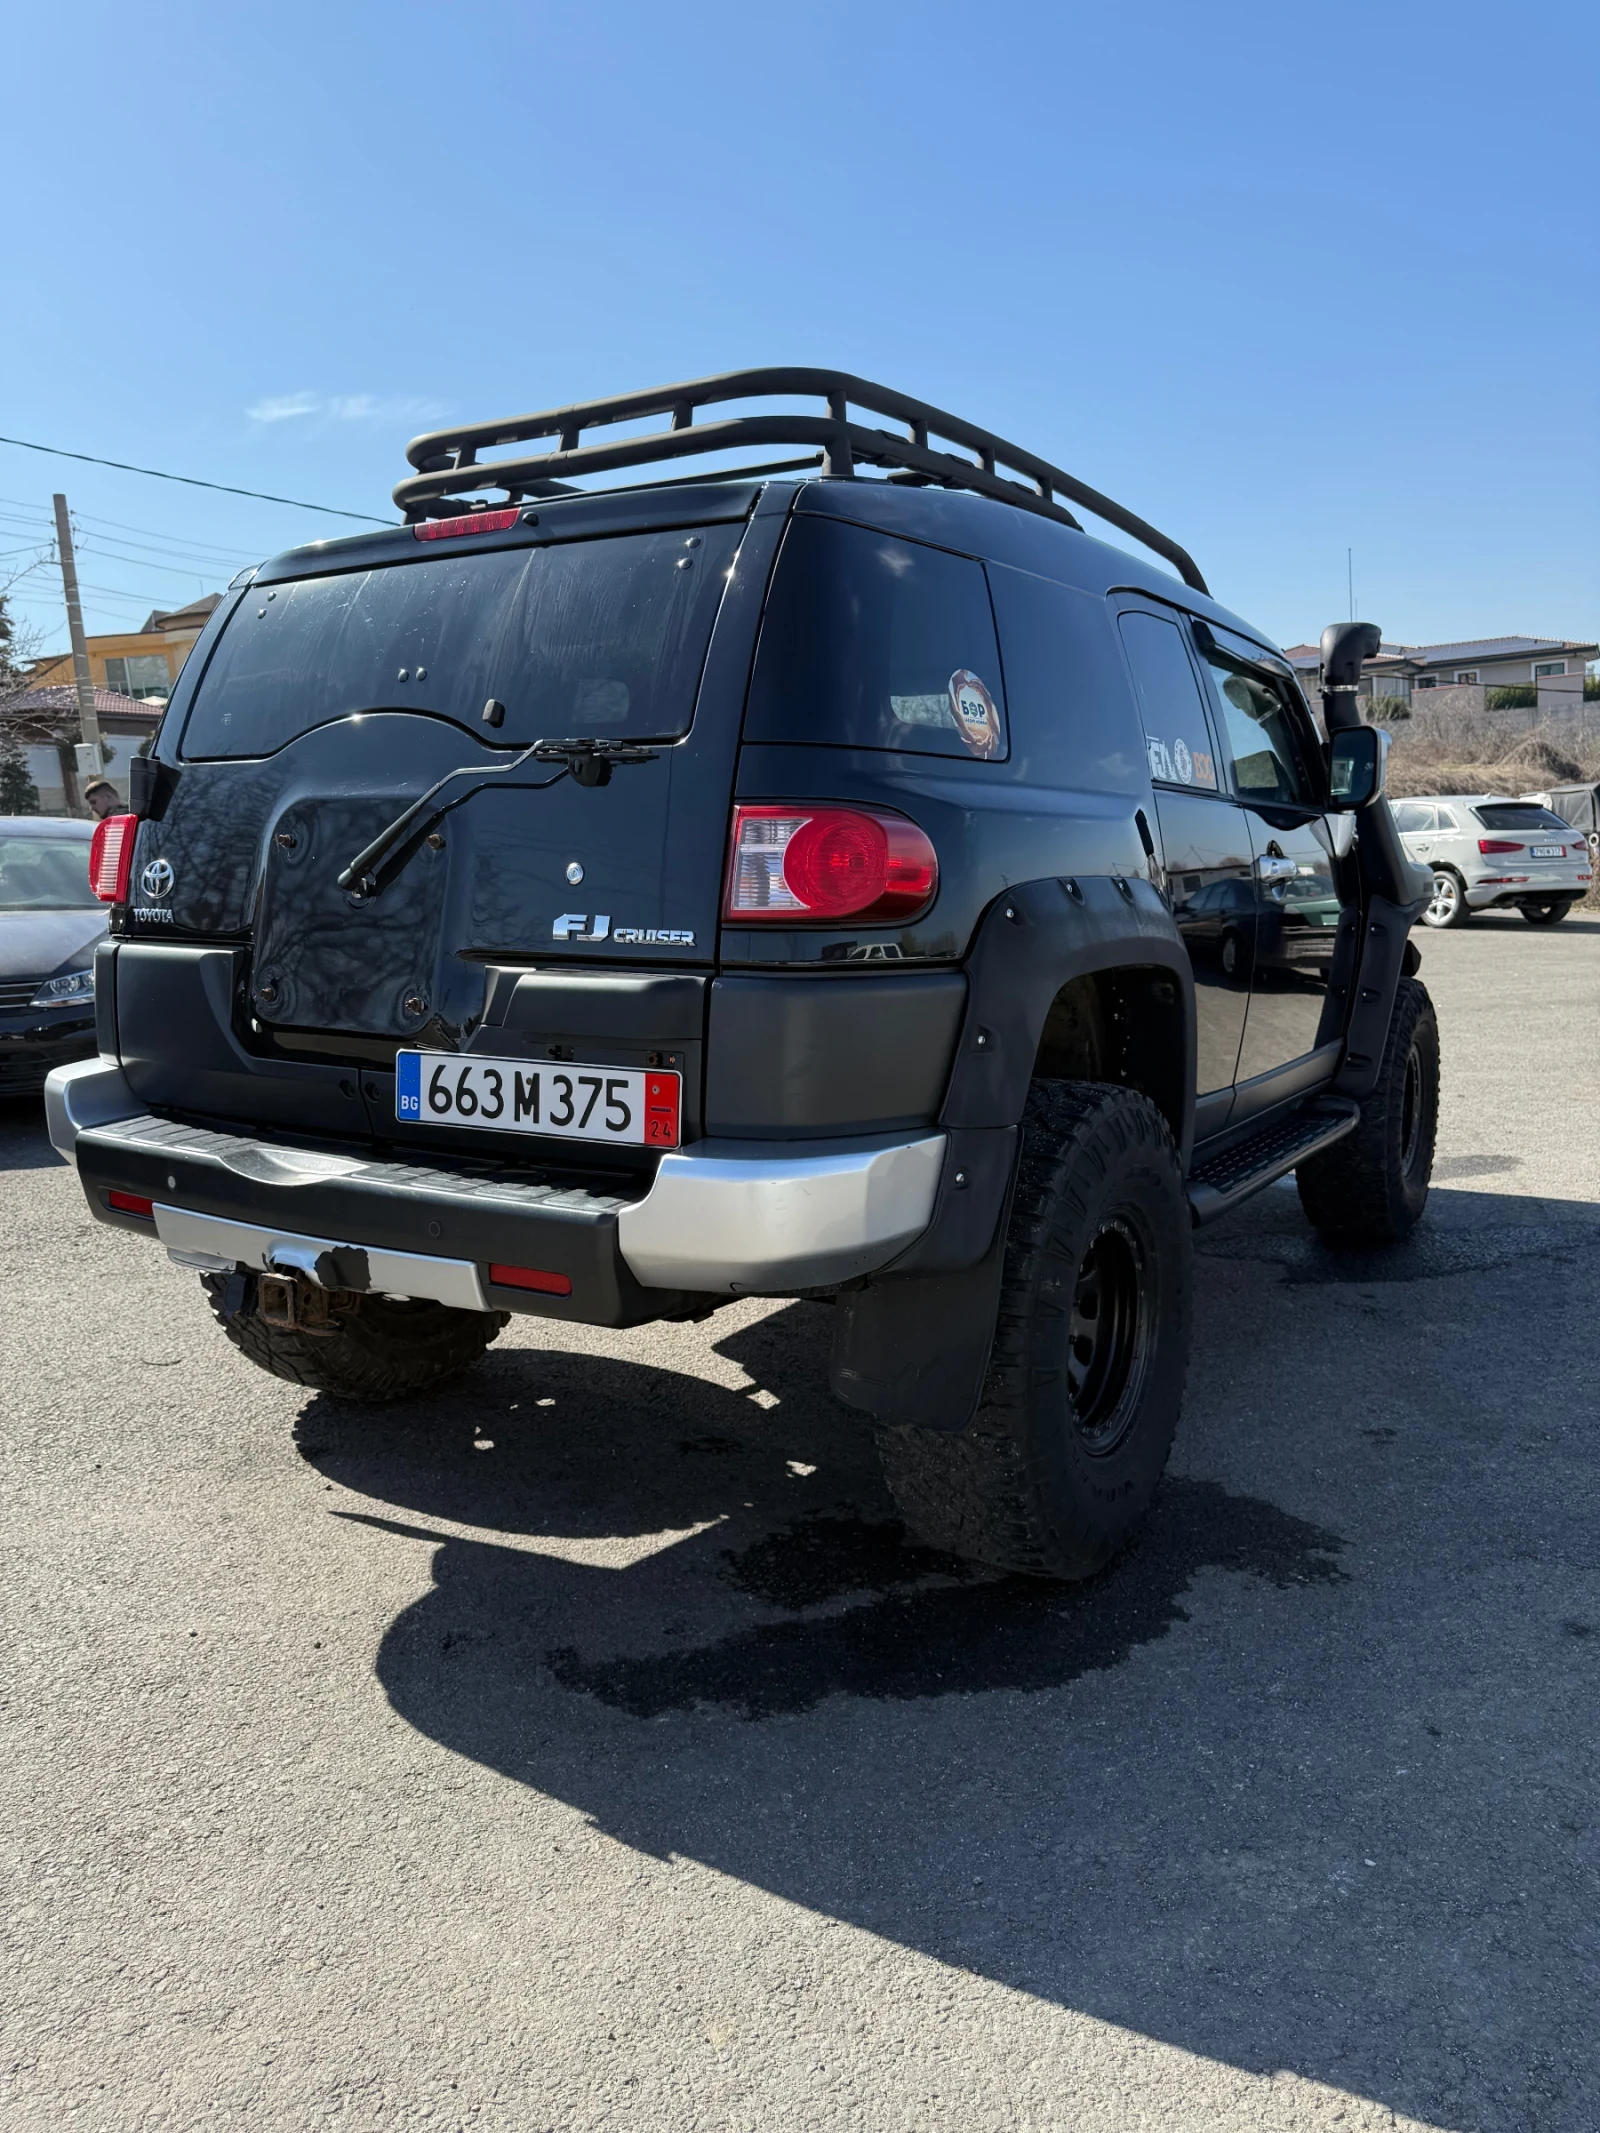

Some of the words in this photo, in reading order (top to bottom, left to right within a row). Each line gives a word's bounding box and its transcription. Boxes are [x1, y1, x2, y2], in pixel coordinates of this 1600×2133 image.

[133, 907, 175, 924] TOYOTA
[552, 913, 612, 942] FJ
[613, 928, 696, 947] CRUISER
[400, 1094, 419, 1111] BG
[651, 1120, 672, 1138] 24
